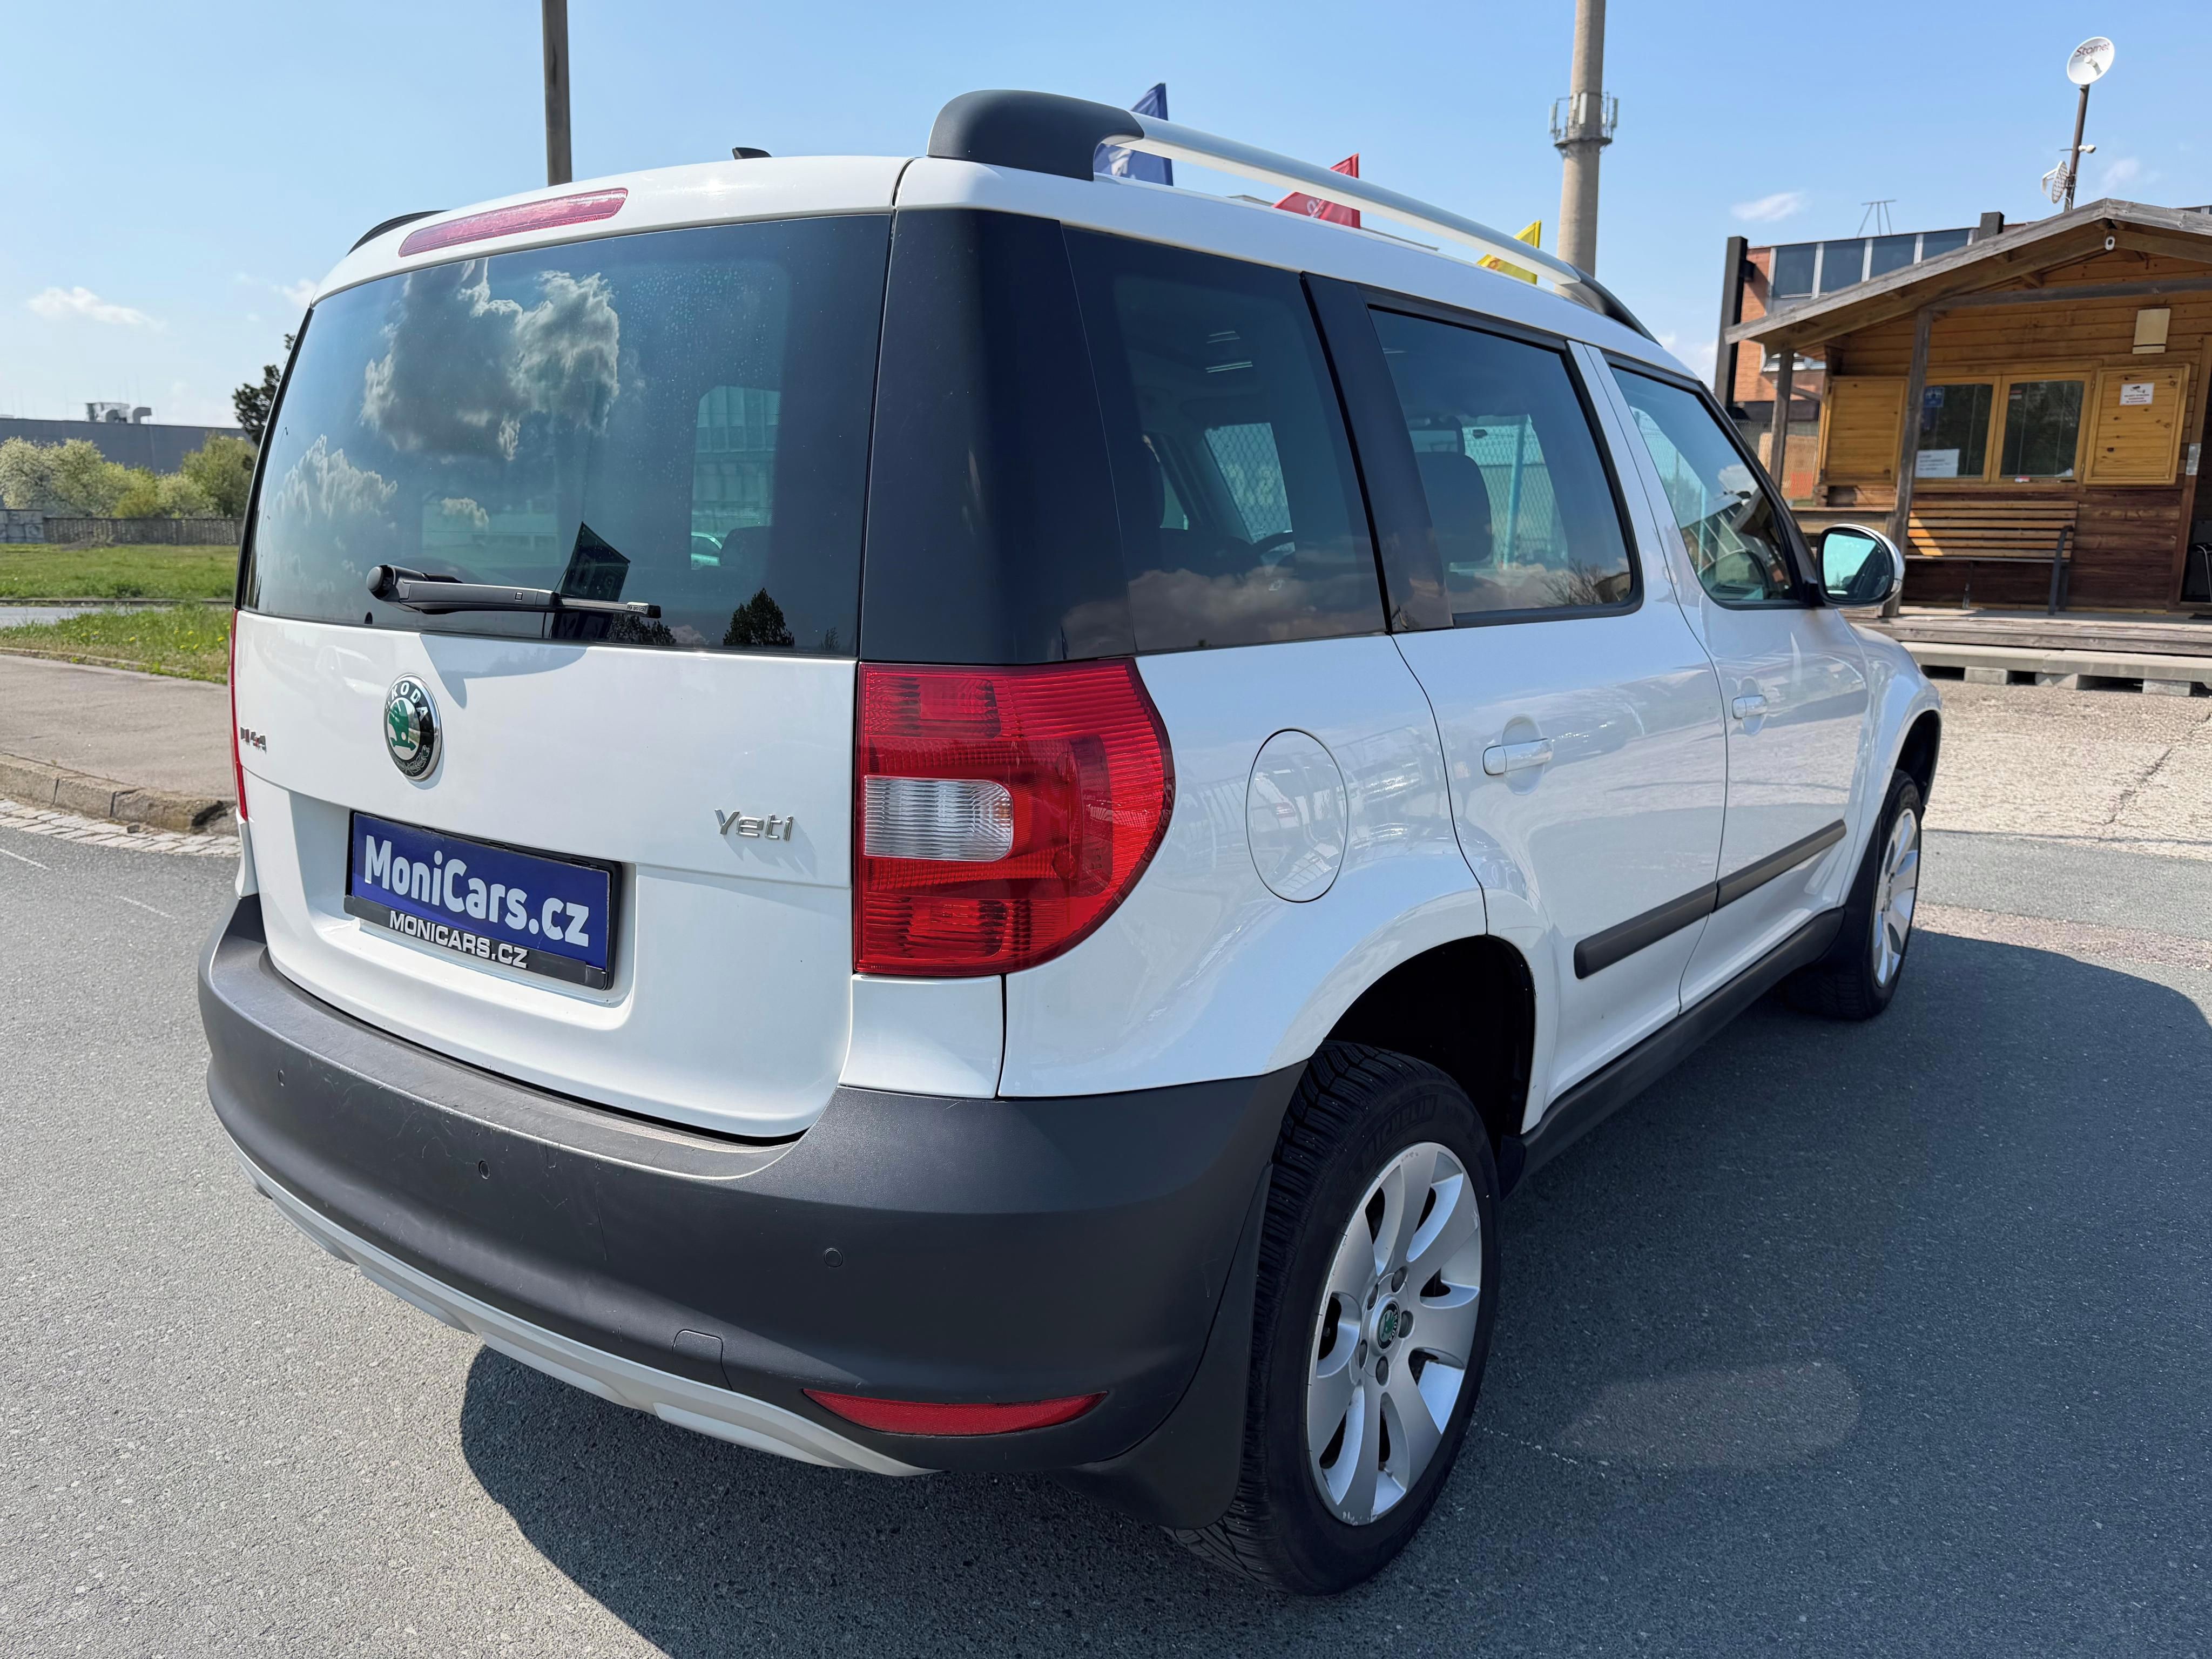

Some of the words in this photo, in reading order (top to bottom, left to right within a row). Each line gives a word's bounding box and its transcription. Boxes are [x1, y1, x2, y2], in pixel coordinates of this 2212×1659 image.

[714, 809, 794, 841] Yeti
[365, 835, 589, 947] MoniCars.cz
[389, 911, 528, 968] MONICARS.CZ
